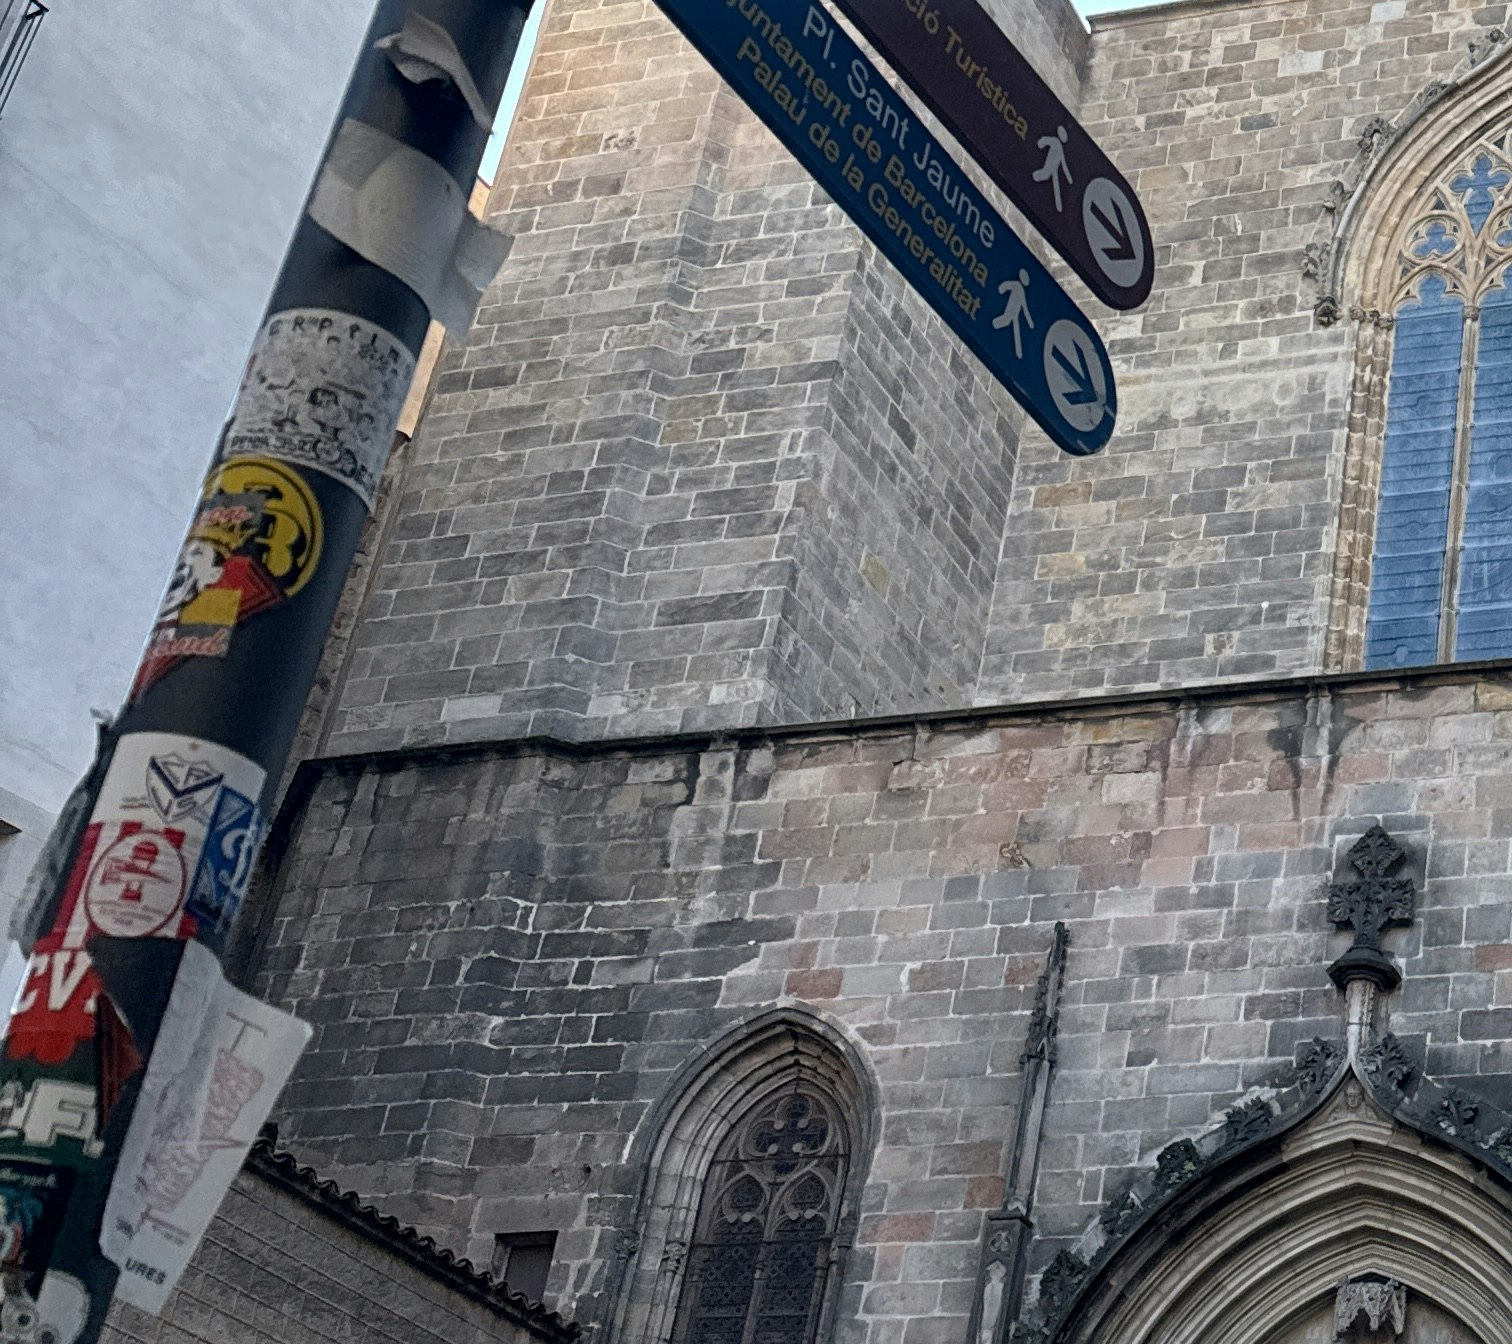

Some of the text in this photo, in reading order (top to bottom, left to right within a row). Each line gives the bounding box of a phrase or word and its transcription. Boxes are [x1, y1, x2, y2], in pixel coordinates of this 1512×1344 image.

[735, 36, 982, 322] Palau de la Generalitat
[802, 5, 995, 249] Pl. Sant Jaume
[851, 123, 883, 164] de
[883, 154, 989, 288] Barcelona
